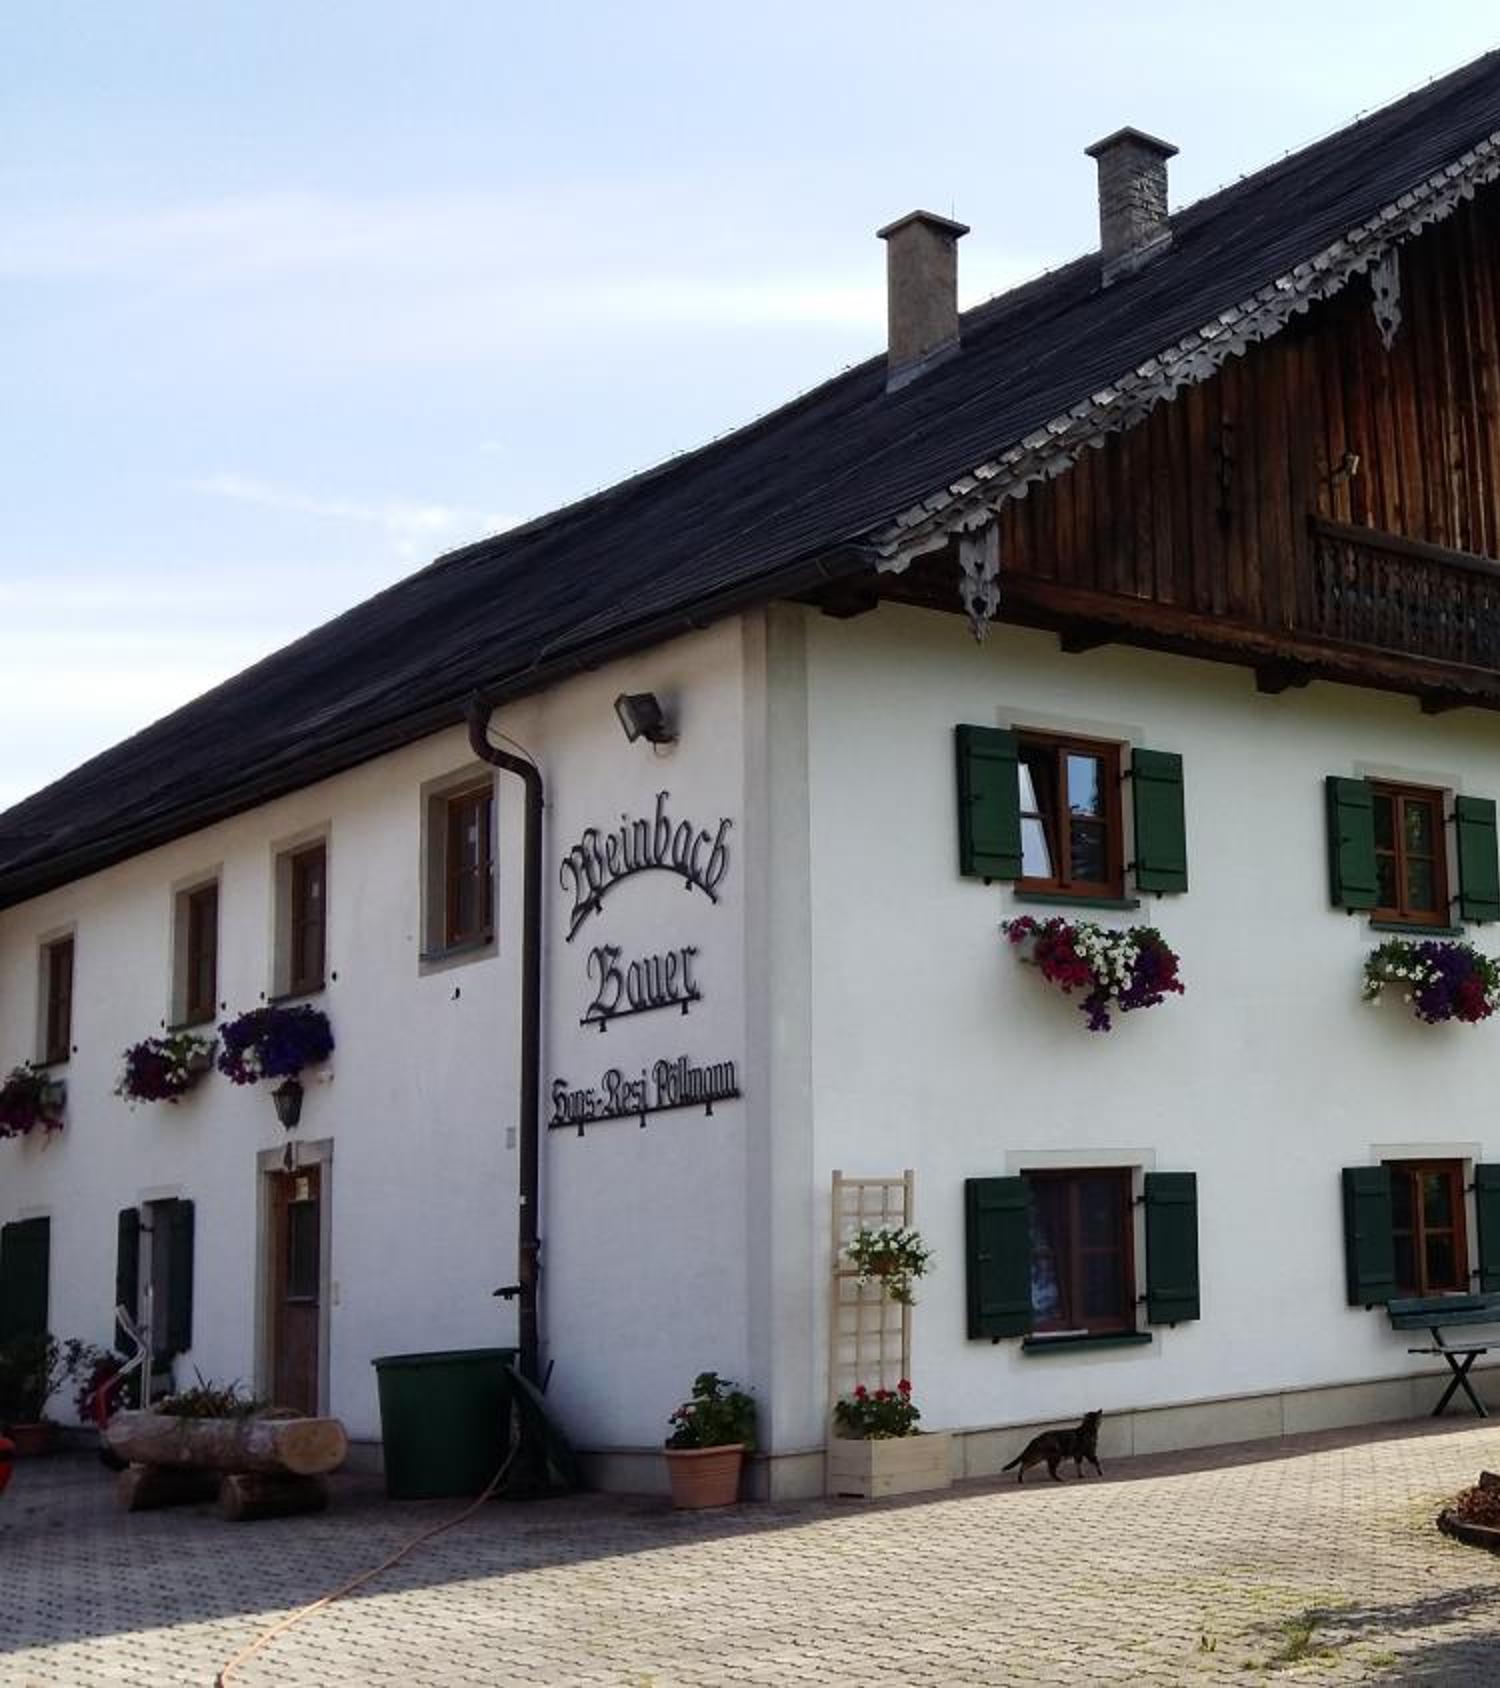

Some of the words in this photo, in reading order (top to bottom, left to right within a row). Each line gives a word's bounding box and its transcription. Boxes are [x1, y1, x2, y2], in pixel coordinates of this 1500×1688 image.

[560, 790, 733, 924] Weinbach
[586, 944, 701, 1019] Bauer
[652, 1055, 738, 1107] Pöllmann
